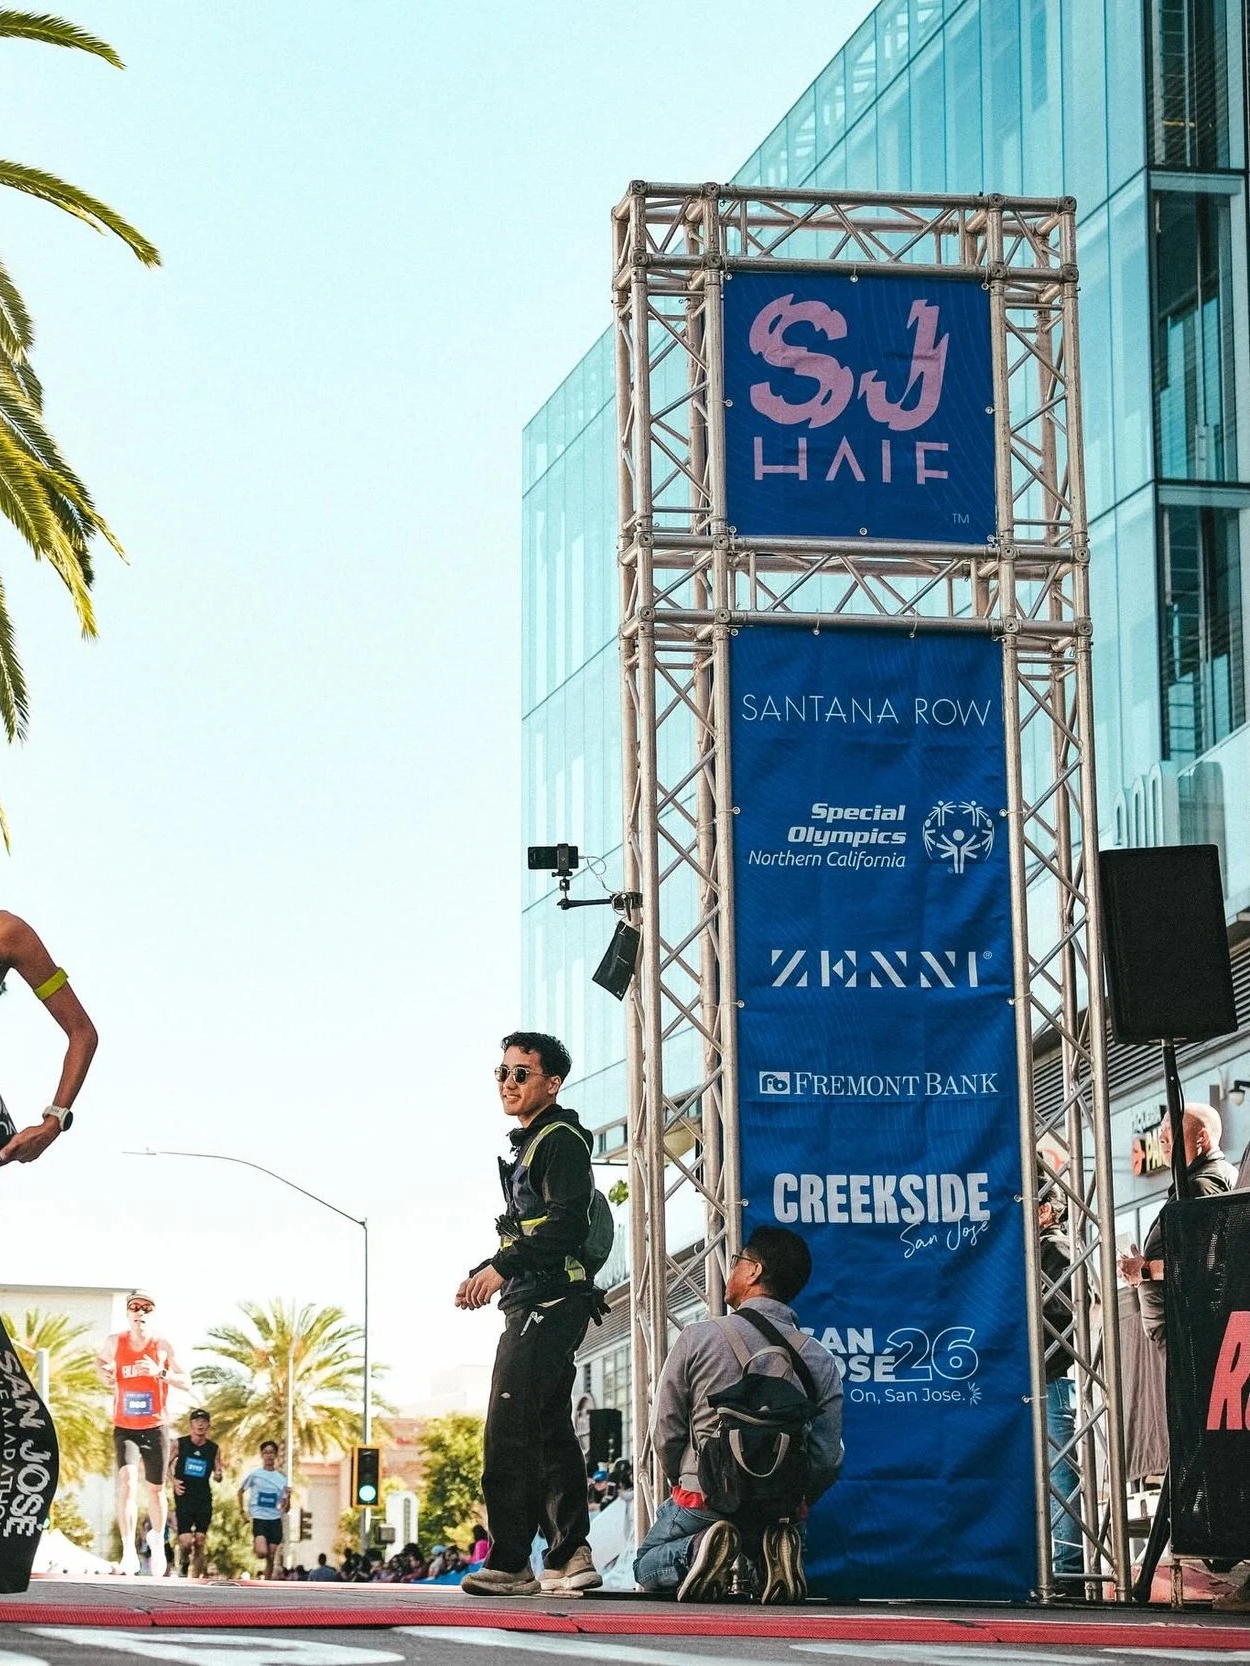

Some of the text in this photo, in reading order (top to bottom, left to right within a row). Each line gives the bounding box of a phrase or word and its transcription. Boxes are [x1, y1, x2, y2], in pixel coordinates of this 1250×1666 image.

[749, 293, 949, 431] SJ
[952, 513, 970, 525] TM
[741, 694, 991, 727] SANTANA ROW
[811, 802, 906, 823] Special
[787, 826, 907, 847] Olympics
[748, 850, 906, 870] Northern California
[793, 1071, 920, 1097] FREMONT
[924, 1071, 998, 1096] BANK
[773, 1172, 990, 1224] CREEKSIDE
[899, 1222, 937, 1258] San
[834, 1347, 896, 1382] SÉ
[886, 1326, 979, 1381] 26
[850, 1388, 966, 1405] On, San Jose.
